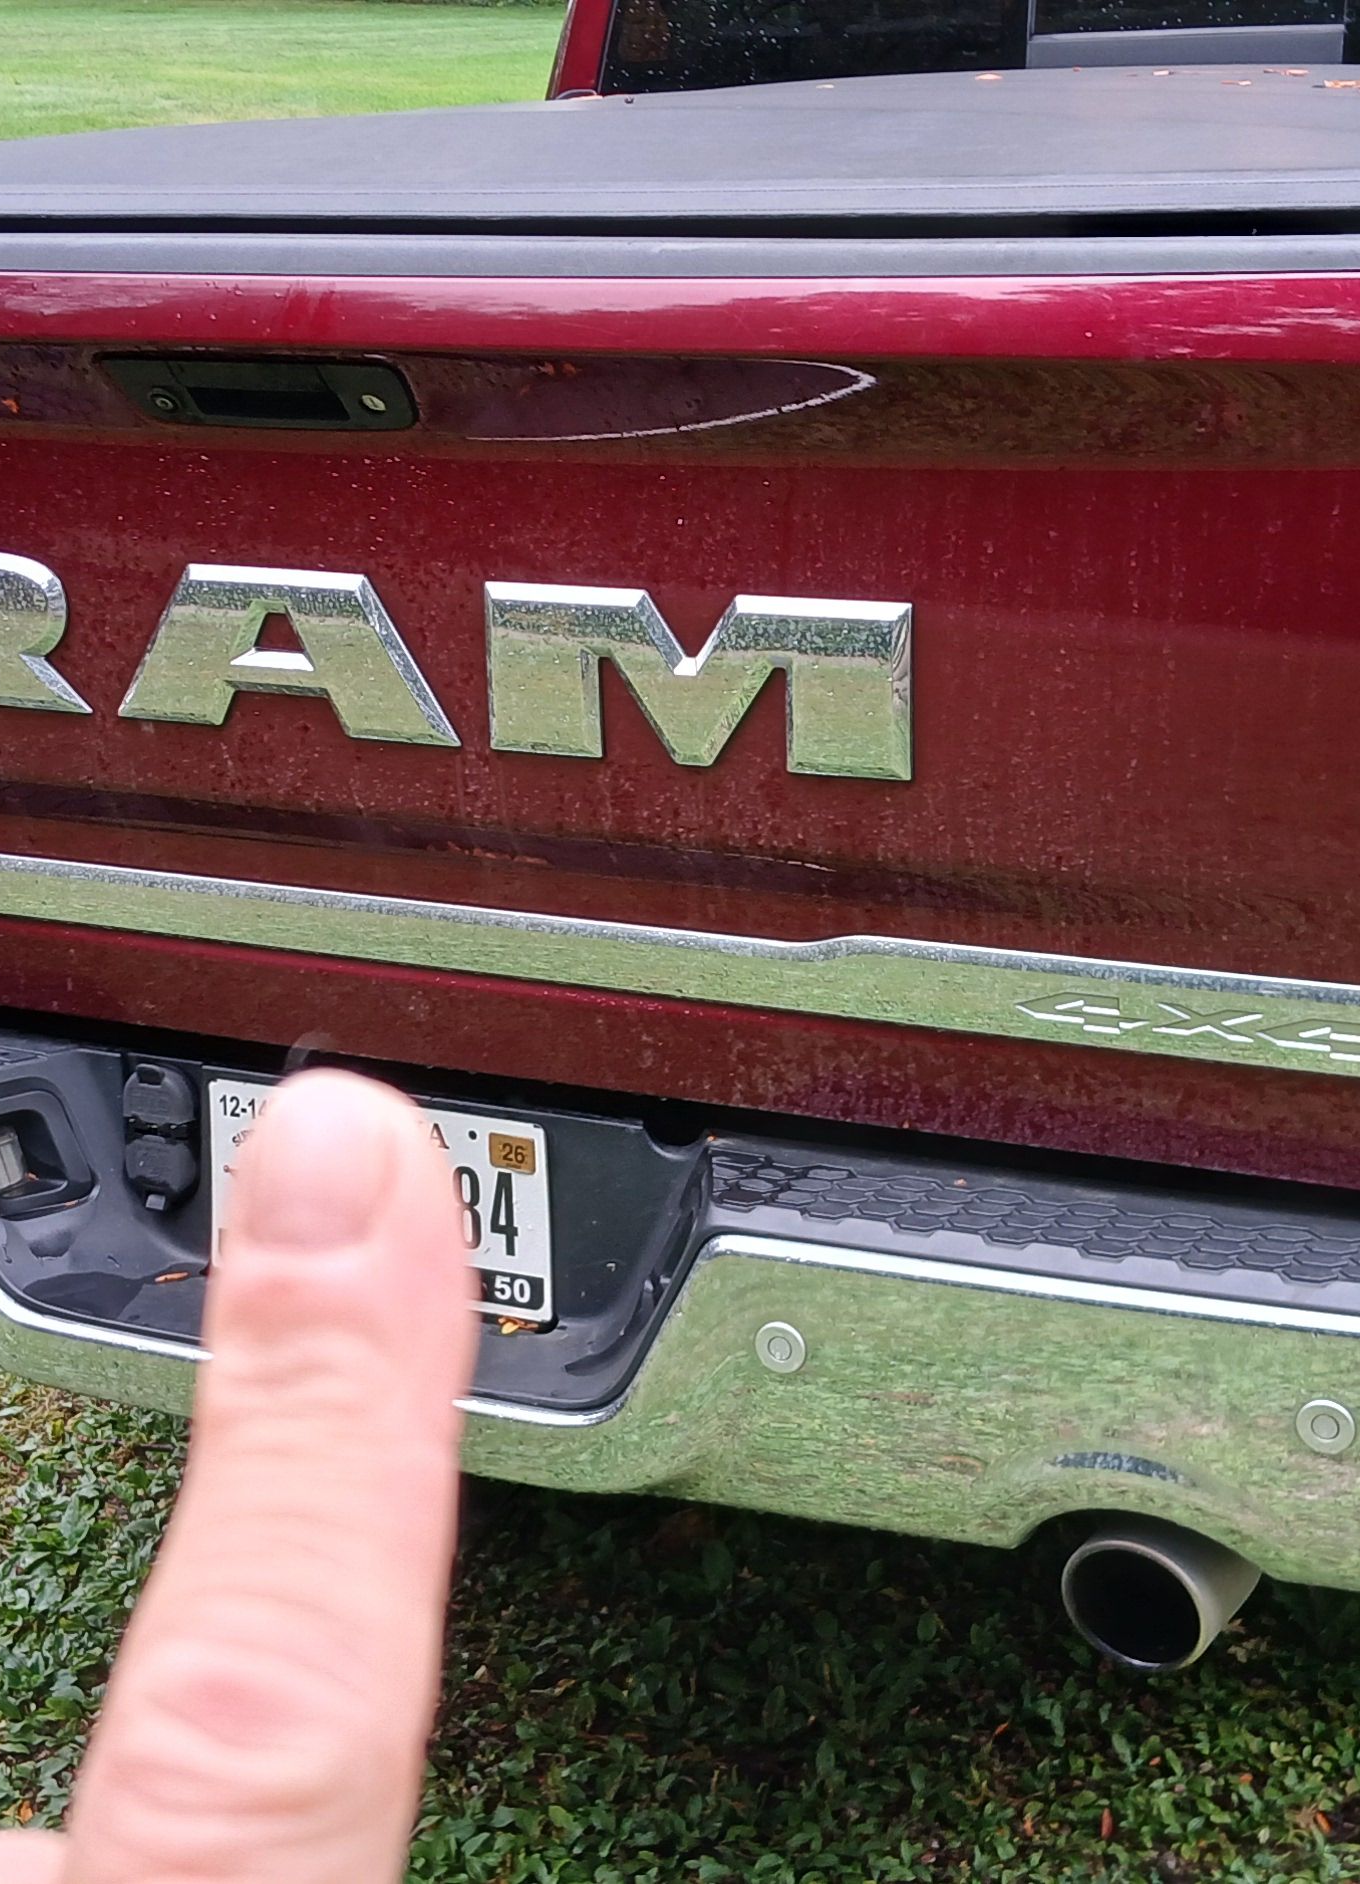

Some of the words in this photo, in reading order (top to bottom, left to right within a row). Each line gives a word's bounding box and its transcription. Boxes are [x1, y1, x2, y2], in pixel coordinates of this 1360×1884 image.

[501, 1142, 526, 1165] 26
[453, 1165, 519, 1257] 84
[494, 1275, 531, 1304] 50
